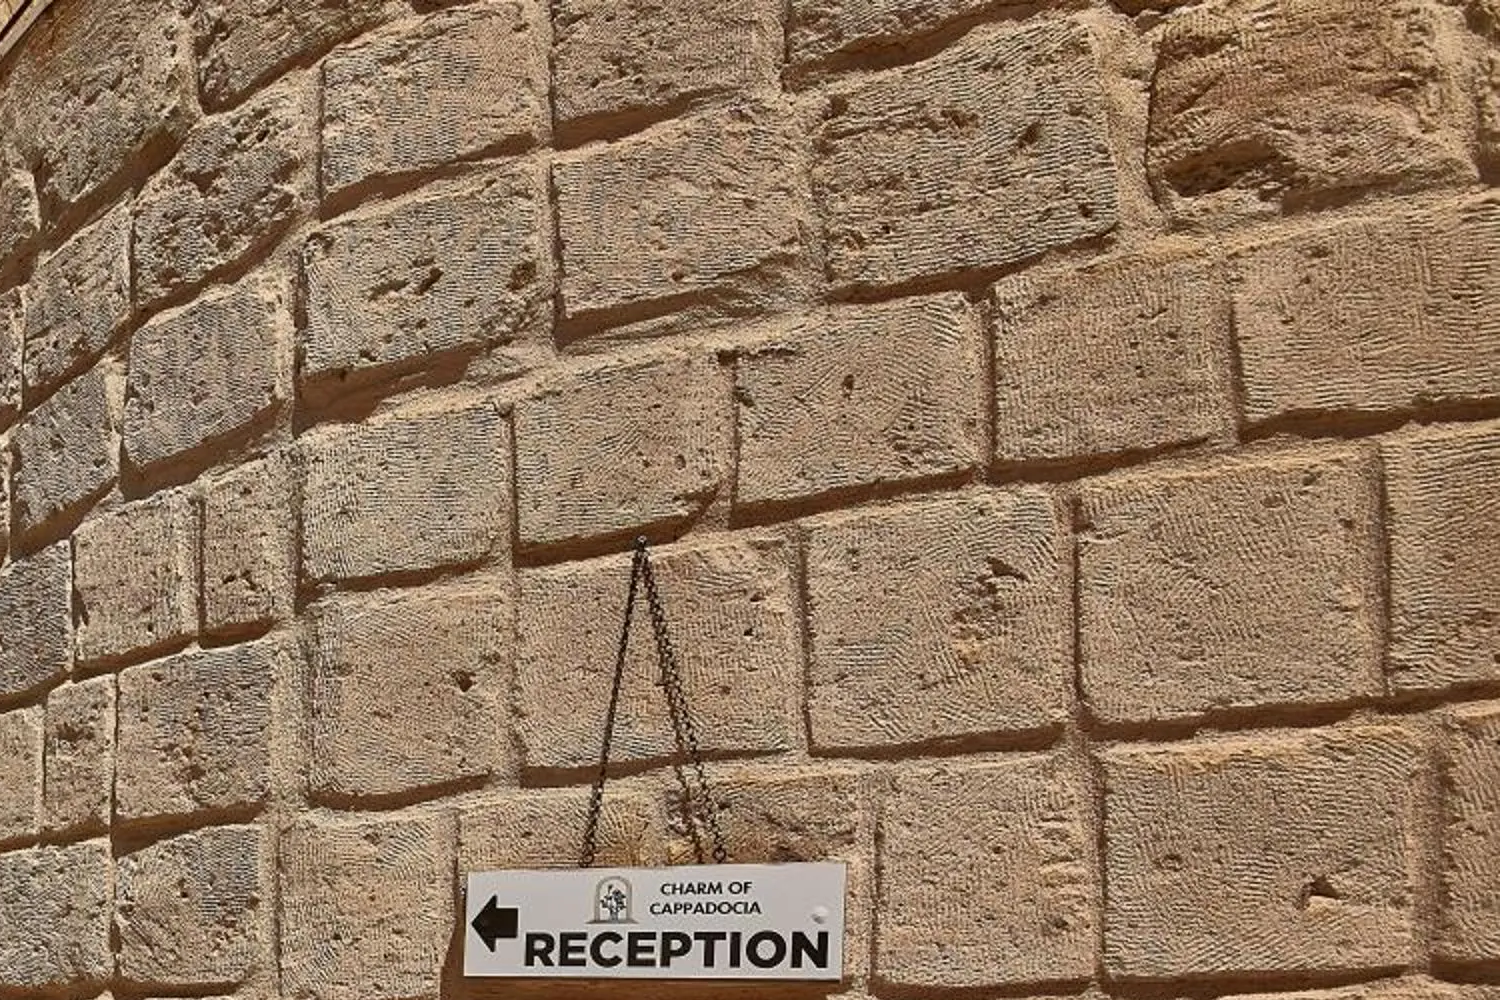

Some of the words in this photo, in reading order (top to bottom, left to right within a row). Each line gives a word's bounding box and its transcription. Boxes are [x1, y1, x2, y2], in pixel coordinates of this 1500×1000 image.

[660, 881, 723, 895] CHARM
[728, 881, 753, 895] OF
[649, 901, 762, 915] CAPPADOCIA
[524, 931, 829, 969] RECEPTION
